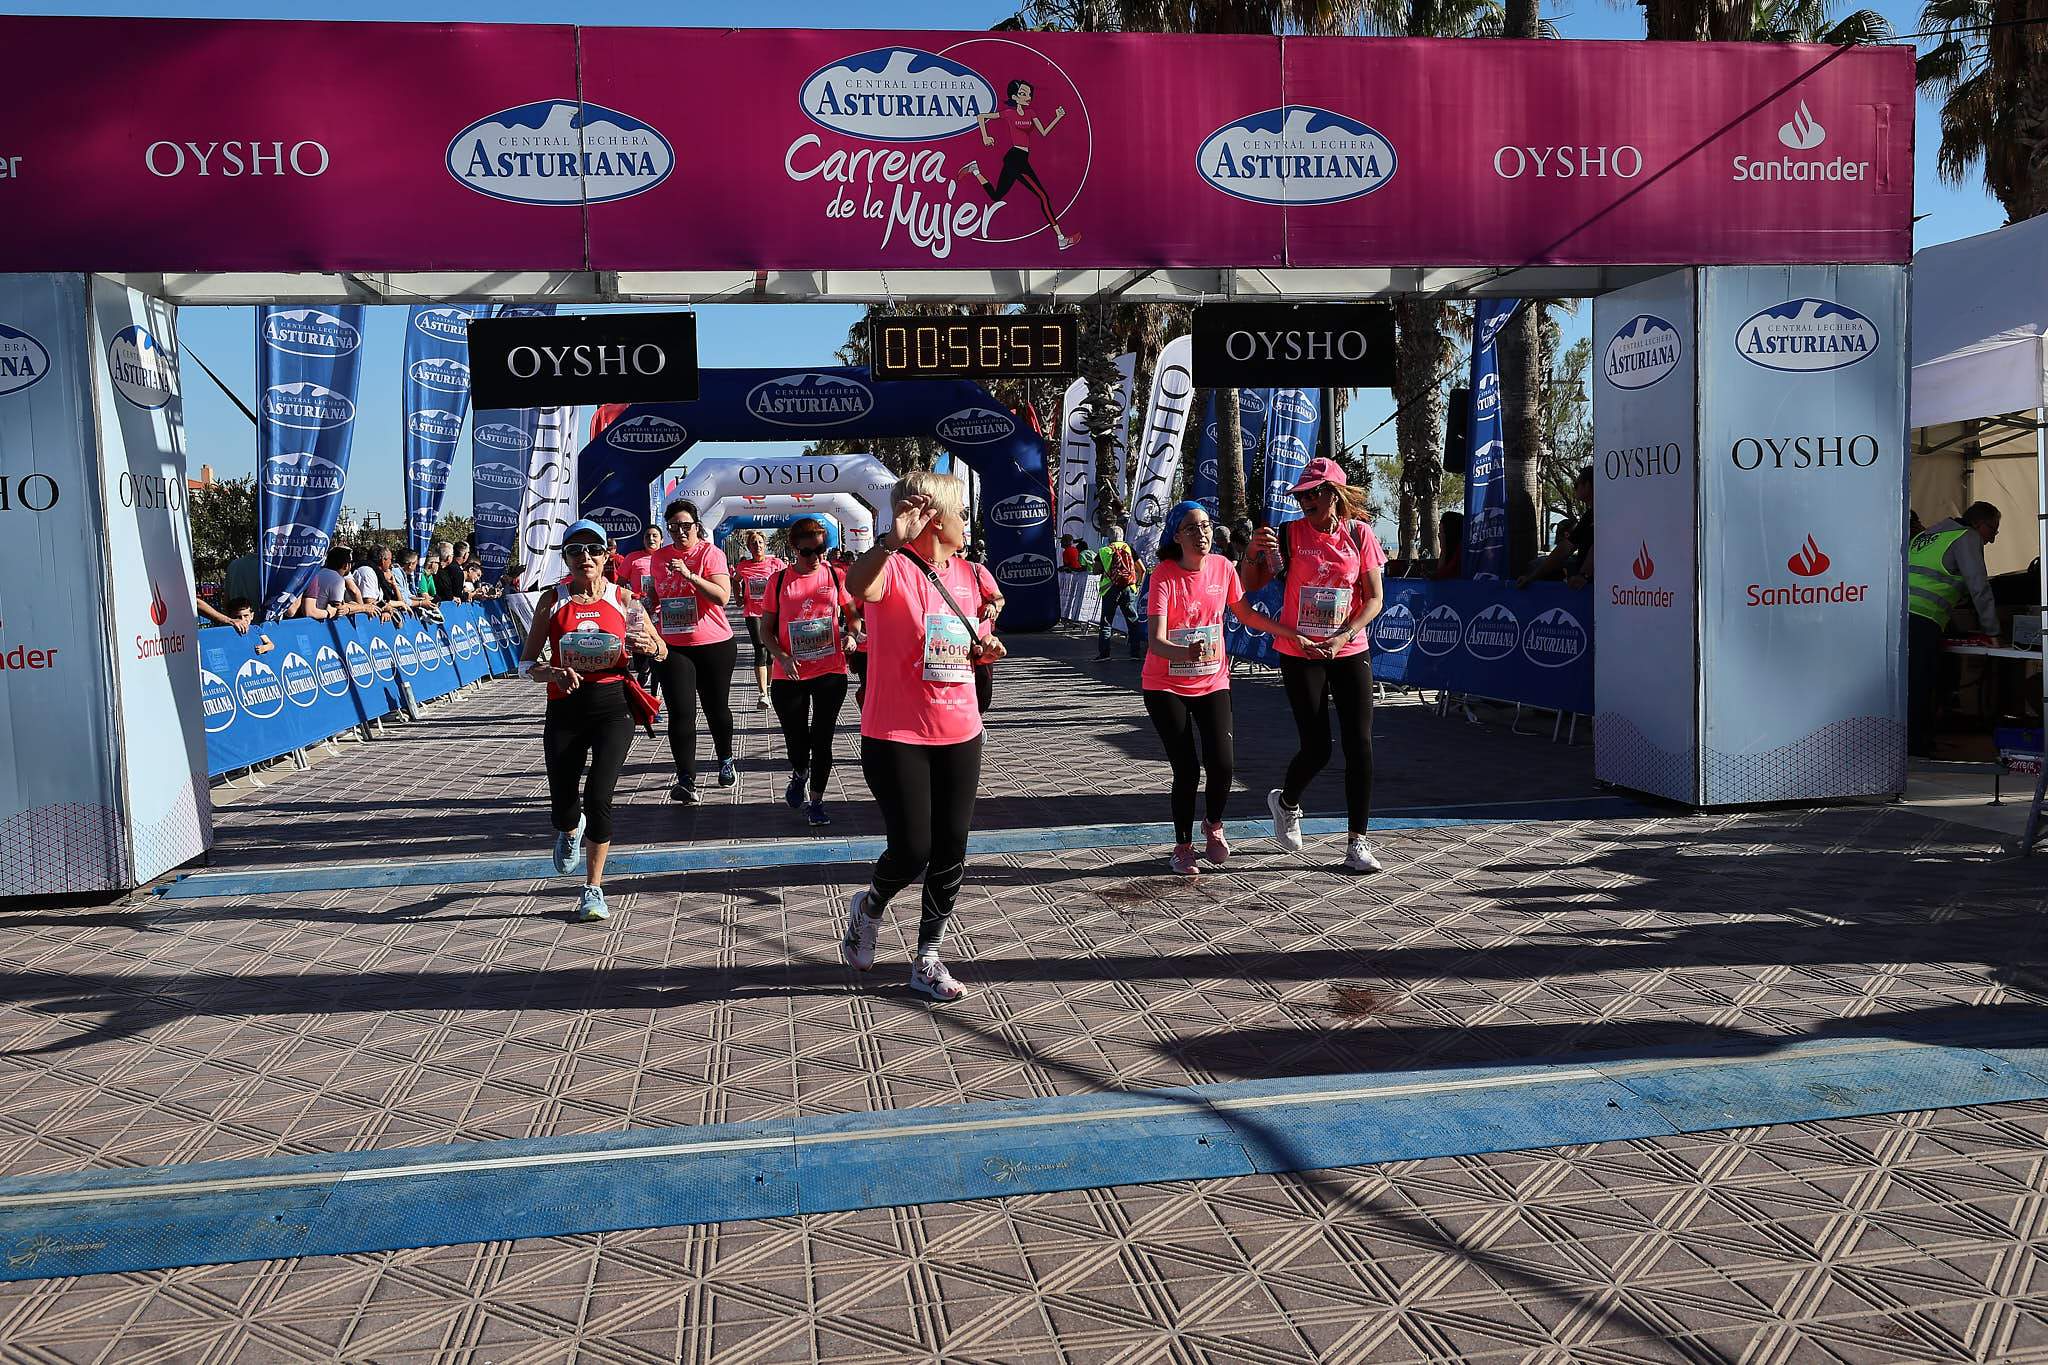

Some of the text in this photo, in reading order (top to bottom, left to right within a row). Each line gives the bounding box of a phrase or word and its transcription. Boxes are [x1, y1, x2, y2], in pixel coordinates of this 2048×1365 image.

[845, 79, 976, 89] CENTRAL LECHERA
[816, 80, 982, 118] ASTURIANA
[499, 136, 570, 146] CENTRAL
[1243, 140, 1375, 150] CENTRAL LECHERA
[145, 140, 330, 177] OYSHO
[465, 138, 658, 178] ASTURIANA
[784, 133, 947, 184] Carrera
[1213, 142, 1382, 179] ASTURIANA
[1493, 145, 1643, 179] OYSHO
[1732, 155, 1869, 182] Santander
[826, 179, 1007, 259] de la Mujer
[267, 322, 354, 349] ASTURIANA
[420, 315, 468, 336] ASTURIA
[1767, 323, 1864, 332] CENTRAL LECHERA
[885, 325, 1062, 368] 00:58:53
[1226, 330, 1368, 361] OYSHO
[1644, 333, 1673, 347] LECHERA
[1746, 326, 1868, 354] ASTURIANA
[115, 349, 170, 393] ASTURIANA
[507, 344, 666, 378] OYSHO
[1608, 344, 1675, 376] ASTURIANA
[414, 365, 471, 387] ASTURIAN
[267, 395, 347, 420] ASTURIANA
[756, 390, 864, 414] ASTURIANA
[410, 417, 460, 437] ASTURIAN
[478, 429, 528, 447] ASTURIANA
[611, 430, 681, 443] ASTURIANA
[943, 423, 1011, 438] ASTURIANA
[1134, 364, 1191, 528] OYSHO
[1731, 434, 1879, 471] OYSHO
[1605, 442, 1681, 480] OYSHO
[739, 463, 839, 486] OYSHO
[119, 471, 182, 512] OYSHO
[679, 489, 710, 497] OYSHO
[477, 513, 518, 525] STURIANA
[995, 504, 1048, 521] ASTURIANA
[1000, 565, 1052, 580] ASTURIANA
[1611, 584, 1675, 608] Santander
[1747, 581, 1868, 607] Santander
[135, 631, 186, 659] Santander
[240, 684, 282, 707] ASTURIANA
